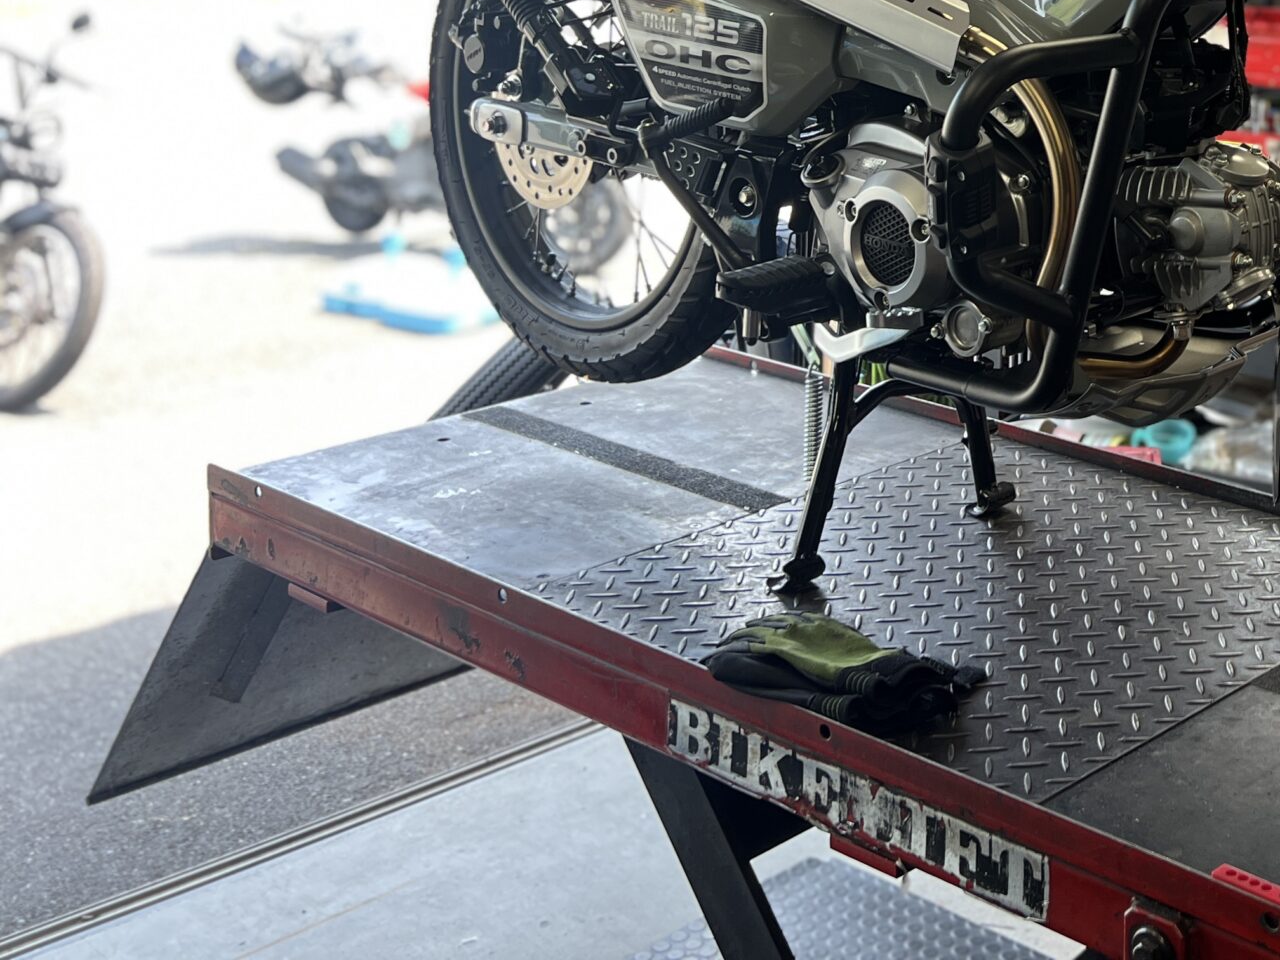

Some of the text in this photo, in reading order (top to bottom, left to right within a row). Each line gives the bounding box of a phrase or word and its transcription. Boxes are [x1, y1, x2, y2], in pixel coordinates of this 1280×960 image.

[641, 11, 741, 45] TRAIL 125
[645, 39, 753, 75] OHC
[658, 68, 677, 78] SPEED
[712, 88, 743, 102] SYSTEM
[864, 233, 910, 258] HONDA
[672, 700, 842, 826] BIKE
